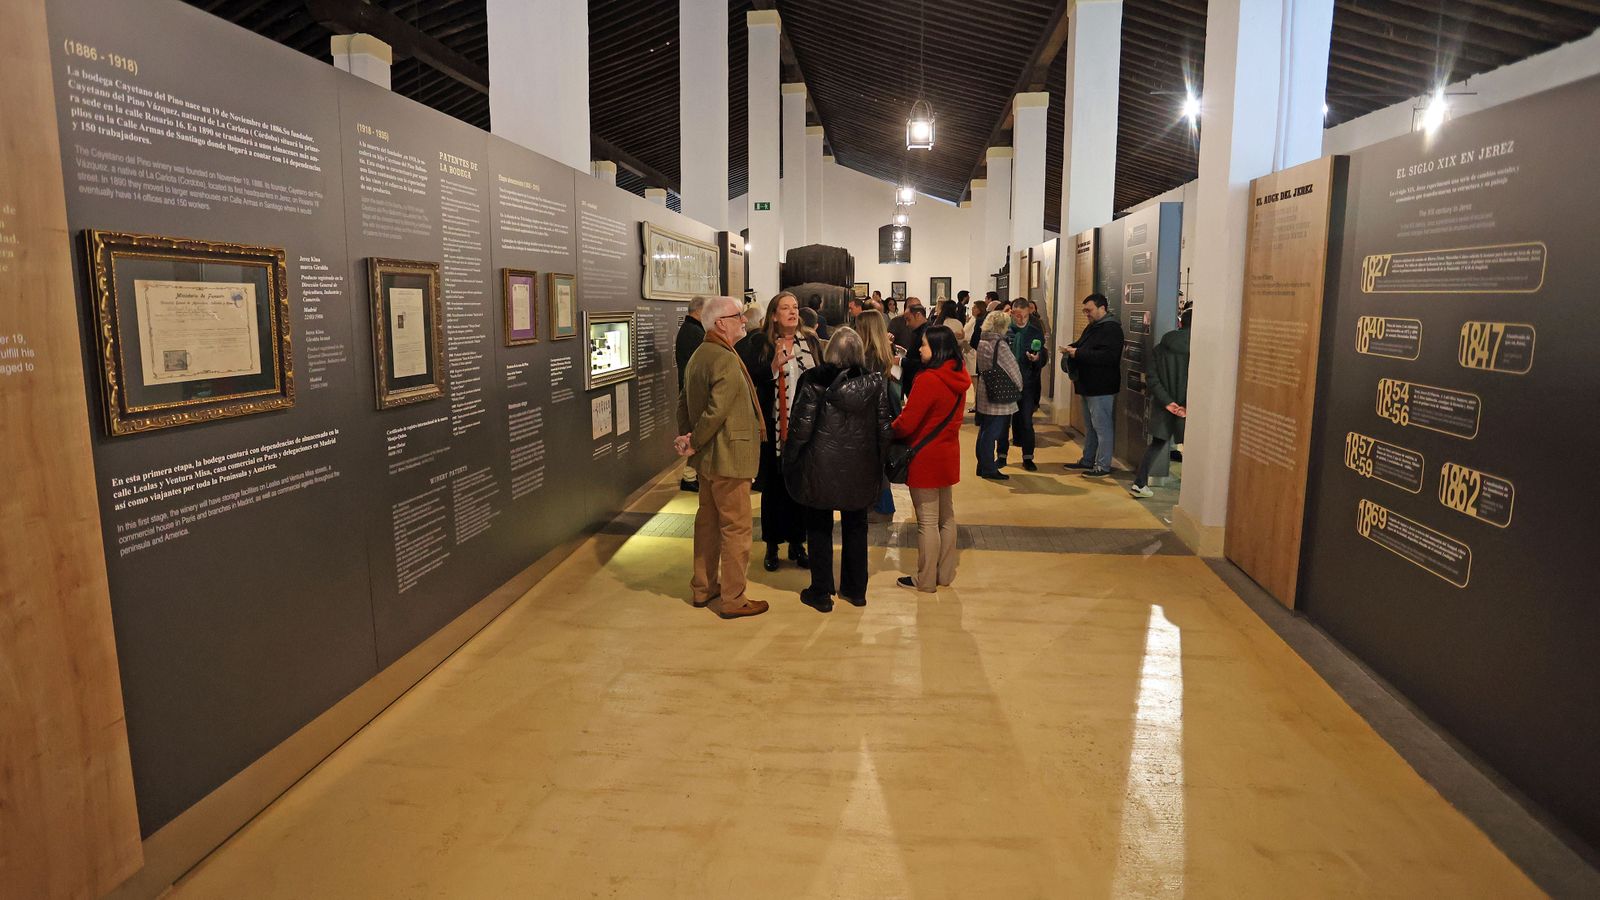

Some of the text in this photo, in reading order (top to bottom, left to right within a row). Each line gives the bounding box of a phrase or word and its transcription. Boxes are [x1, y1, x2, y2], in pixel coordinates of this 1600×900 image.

[64, 40, 98, 60] (1886
[108, 54, 138, 76] 1918)
[68, 65, 80, 77] La
[82, 70, 113, 87] bodega
[116, 79, 152, 97] Cayetano
[155, 90, 166, 101] del
[168, 94, 183, 105] Pino
[185, 101, 201, 110] nace
[212, 107, 220, 115] 19
[221, 109, 228, 118] de
[230, 112, 261, 127] Noviembre
[262, 121, 269, 129] de
[68, 79, 110, 98] Cayetano
[113, 91, 125, 102] del
[127, 95, 145, 107] Pino
[146, 100, 180, 118] Vázquez,
[182, 112, 207, 123] natural
[208, 117, 215, 125] de
[216, 119, 225, 128] La
[227, 122, 249, 134] Carlota
[71, 107, 91, 119] plios
[107, 115, 115, 124] la
[117, 117, 137, 129] Calle
[138, 122, 165, 135] Armas
[166, 129, 176, 138] de
[176, 131, 206, 146] Santiago
[207, 138, 226, 149] donde
[253, 151, 271, 160] contar
[73, 121, 152, 144] y 150 trabajadores.
[82, 98, 101, 108] sede
[116, 104, 123, 114] la
[125, 109, 143, 119] calle
[145, 112, 174, 126] Rosario
[176, 120, 186, 129] 16.
[187, 123, 197, 132] En
[199, 126, 214, 136] 1890
[440, 152, 478, 171] PATENTES DE
[440, 163, 472, 180] LA BODEGA
[1396, 141, 1514, 179] EL SIGLO XIX EN JEREZ
[1280, 190, 1292, 200] DEL
[1293, 184, 1313, 197] JEREZ
[21, 348, 35, 358] his
[1357, 318, 1385, 353] 1840
[1460, 322, 1505, 369] 1847
[25, 362, 34, 371] to
[112, 478, 123, 486] En
[126, 474, 140, 483] esta
[143, 468, 172, 481] primera
[174, 463, 194, 472] etapa,
[203, 455, 225, 465] bodega
[227, 448, 248, 460] contará
[261, 439, 294, 452] dependencias
[113, 488, 131, 498] calle
[134, 482, 157, 493] Lealas
[166, 474, 192, 485] Ventura
[194, 470, 213, 478] Misa,
[227, 457, 255, 470] comercial
[283, 445, 312, 456] delegaciones
[320, 437, 336, 447] Madrid
[115, 500, 126, 510] así
[128, 497, 148, 506] como
[150, 488, 182, 501] viajantes
[183, 485, 194, 494] por
[196, 480, 210, 488] toda
[219, 470, 247, 482] Península
[253, 464, 278, 473] América.
[1440, 463, 1480, 517] 1862
[118, 524, 124, 532] In
[126, 520, 136, 530] this
[138, 516, 149, 526] first
[151, 514, 167, 522] stage,
[170, 508, 179, 517] the
[180, 504, 198, 514] winery
[200, 499, 208, 508] will
[222, 492, 240, 502] storage
[119, 526, 155, 544] commercial
[156, 522, 174, 532] house
[182, 514, 196, 524] Paris
[197, 510, 207, 520] and
[208, 504, 231, 516] branches
[1358, 500, 1386, 538] 1869
[120, 540, 150, 557] peninsula
[152, 535, 164, 545] and
